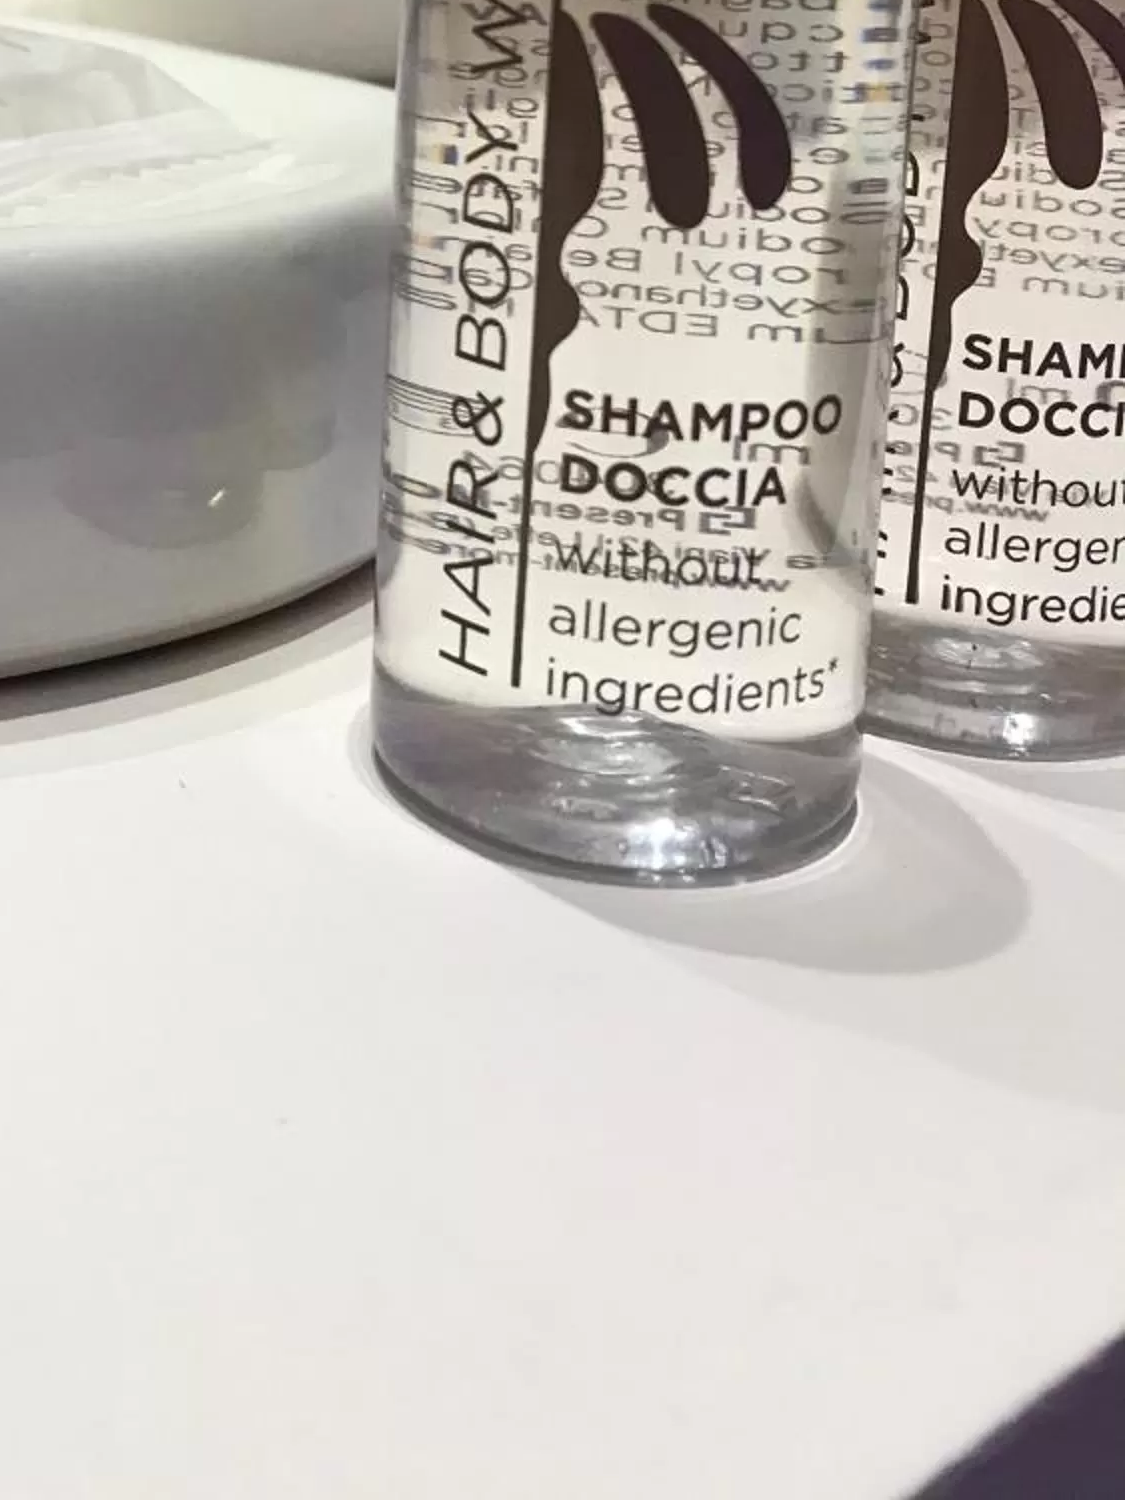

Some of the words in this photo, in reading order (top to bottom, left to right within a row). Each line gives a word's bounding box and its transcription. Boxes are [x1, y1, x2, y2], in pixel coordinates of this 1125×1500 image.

[455, 110, 518, 371] BODY
[961, 334, 1125, 379] SHAM
[452, 390, 504, 446] &
[562, 389, 842, 443] SHAMPOO
[958, 390, 1125, 439] DOCCI
[559, 453, 787, 508] DOCCIA
[438, 461, 499, 676] HAIR
[548, 600, 802, 657] allergenic
